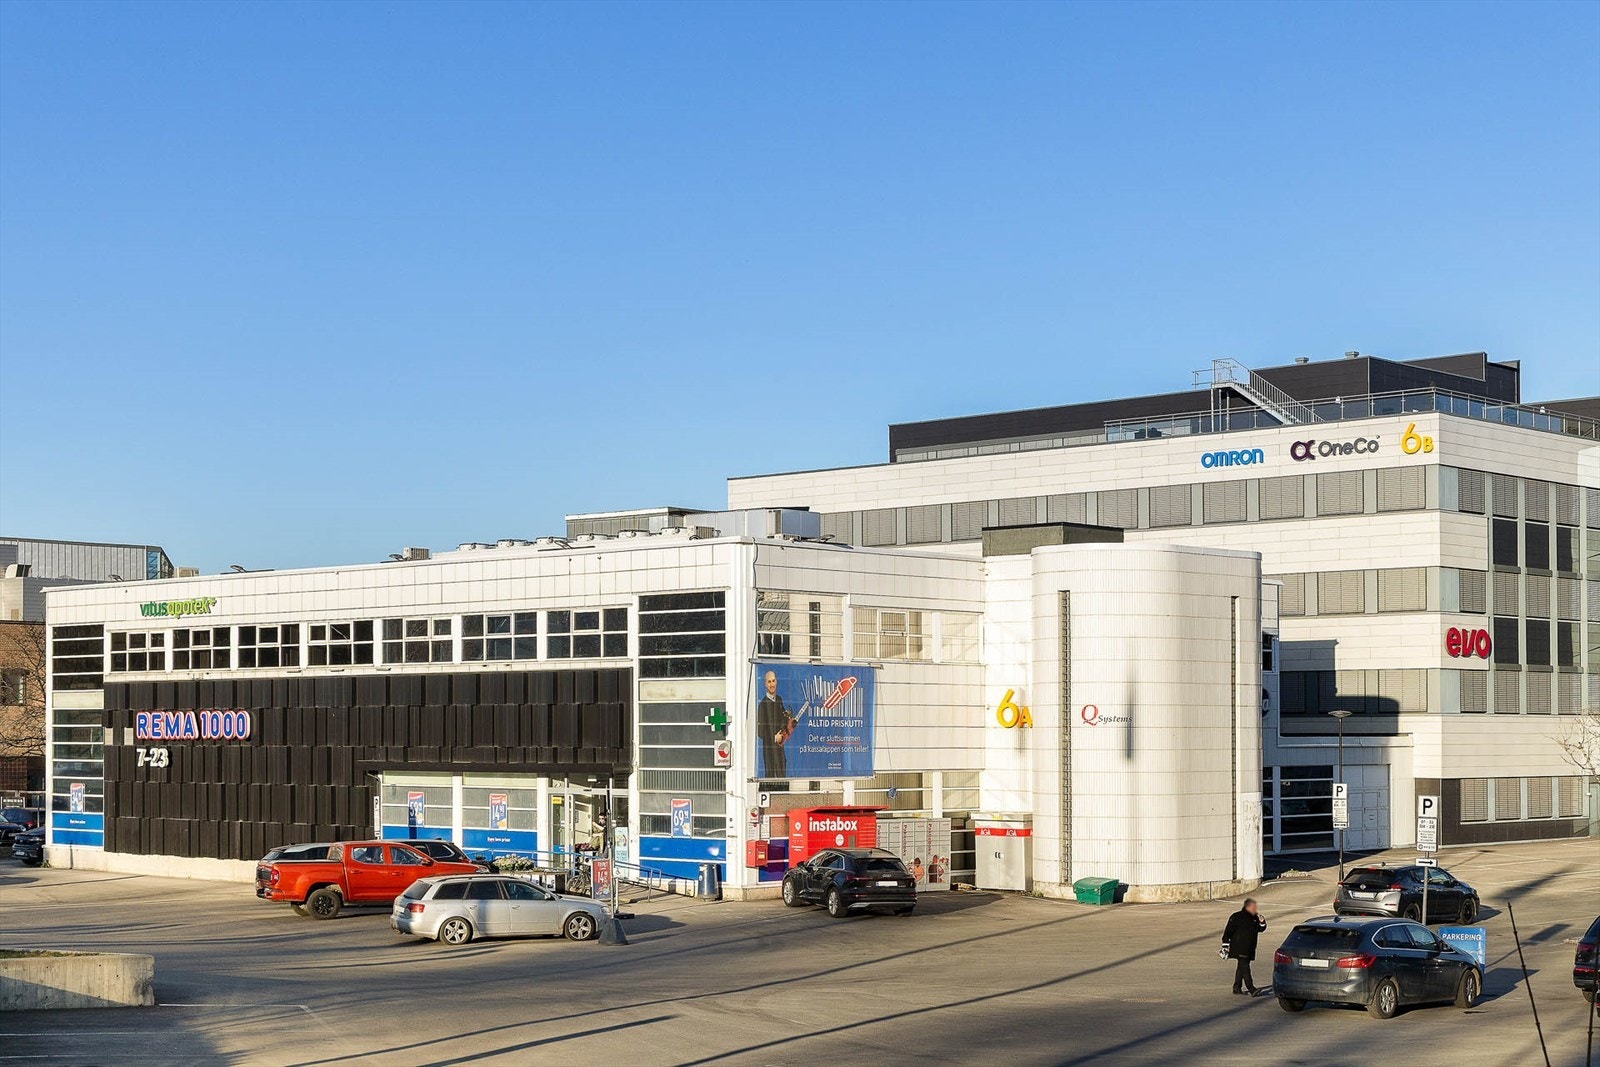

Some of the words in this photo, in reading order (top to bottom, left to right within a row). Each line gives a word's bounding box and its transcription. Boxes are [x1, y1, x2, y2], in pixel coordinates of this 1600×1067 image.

[1318, 437, 1380, 458] OneCo
[1446, 627, 1492, 659] evo
[136, 710, 199, 741] REMA
[200, 710, 251, 740] 1000
[808, 719, 830, 728] ALLTID
[831, 719, 863, 728] PRISKUTT!
[808, 734, 819, 742] Det
[826, 734, 861, 743] sluttsummen
[808, 745, 840, 754] kassalappen
[136, 748, 169, 768] 7-23
[1336, 785, 1343, 797] P
[761, 793, 768, 805] P
[1422, 798, 1433, 815] P
[673, 809, 685, 826] 69
[809, 817, 858, 832] instabox
[1442, 933, 1483, 942] PARKERING
